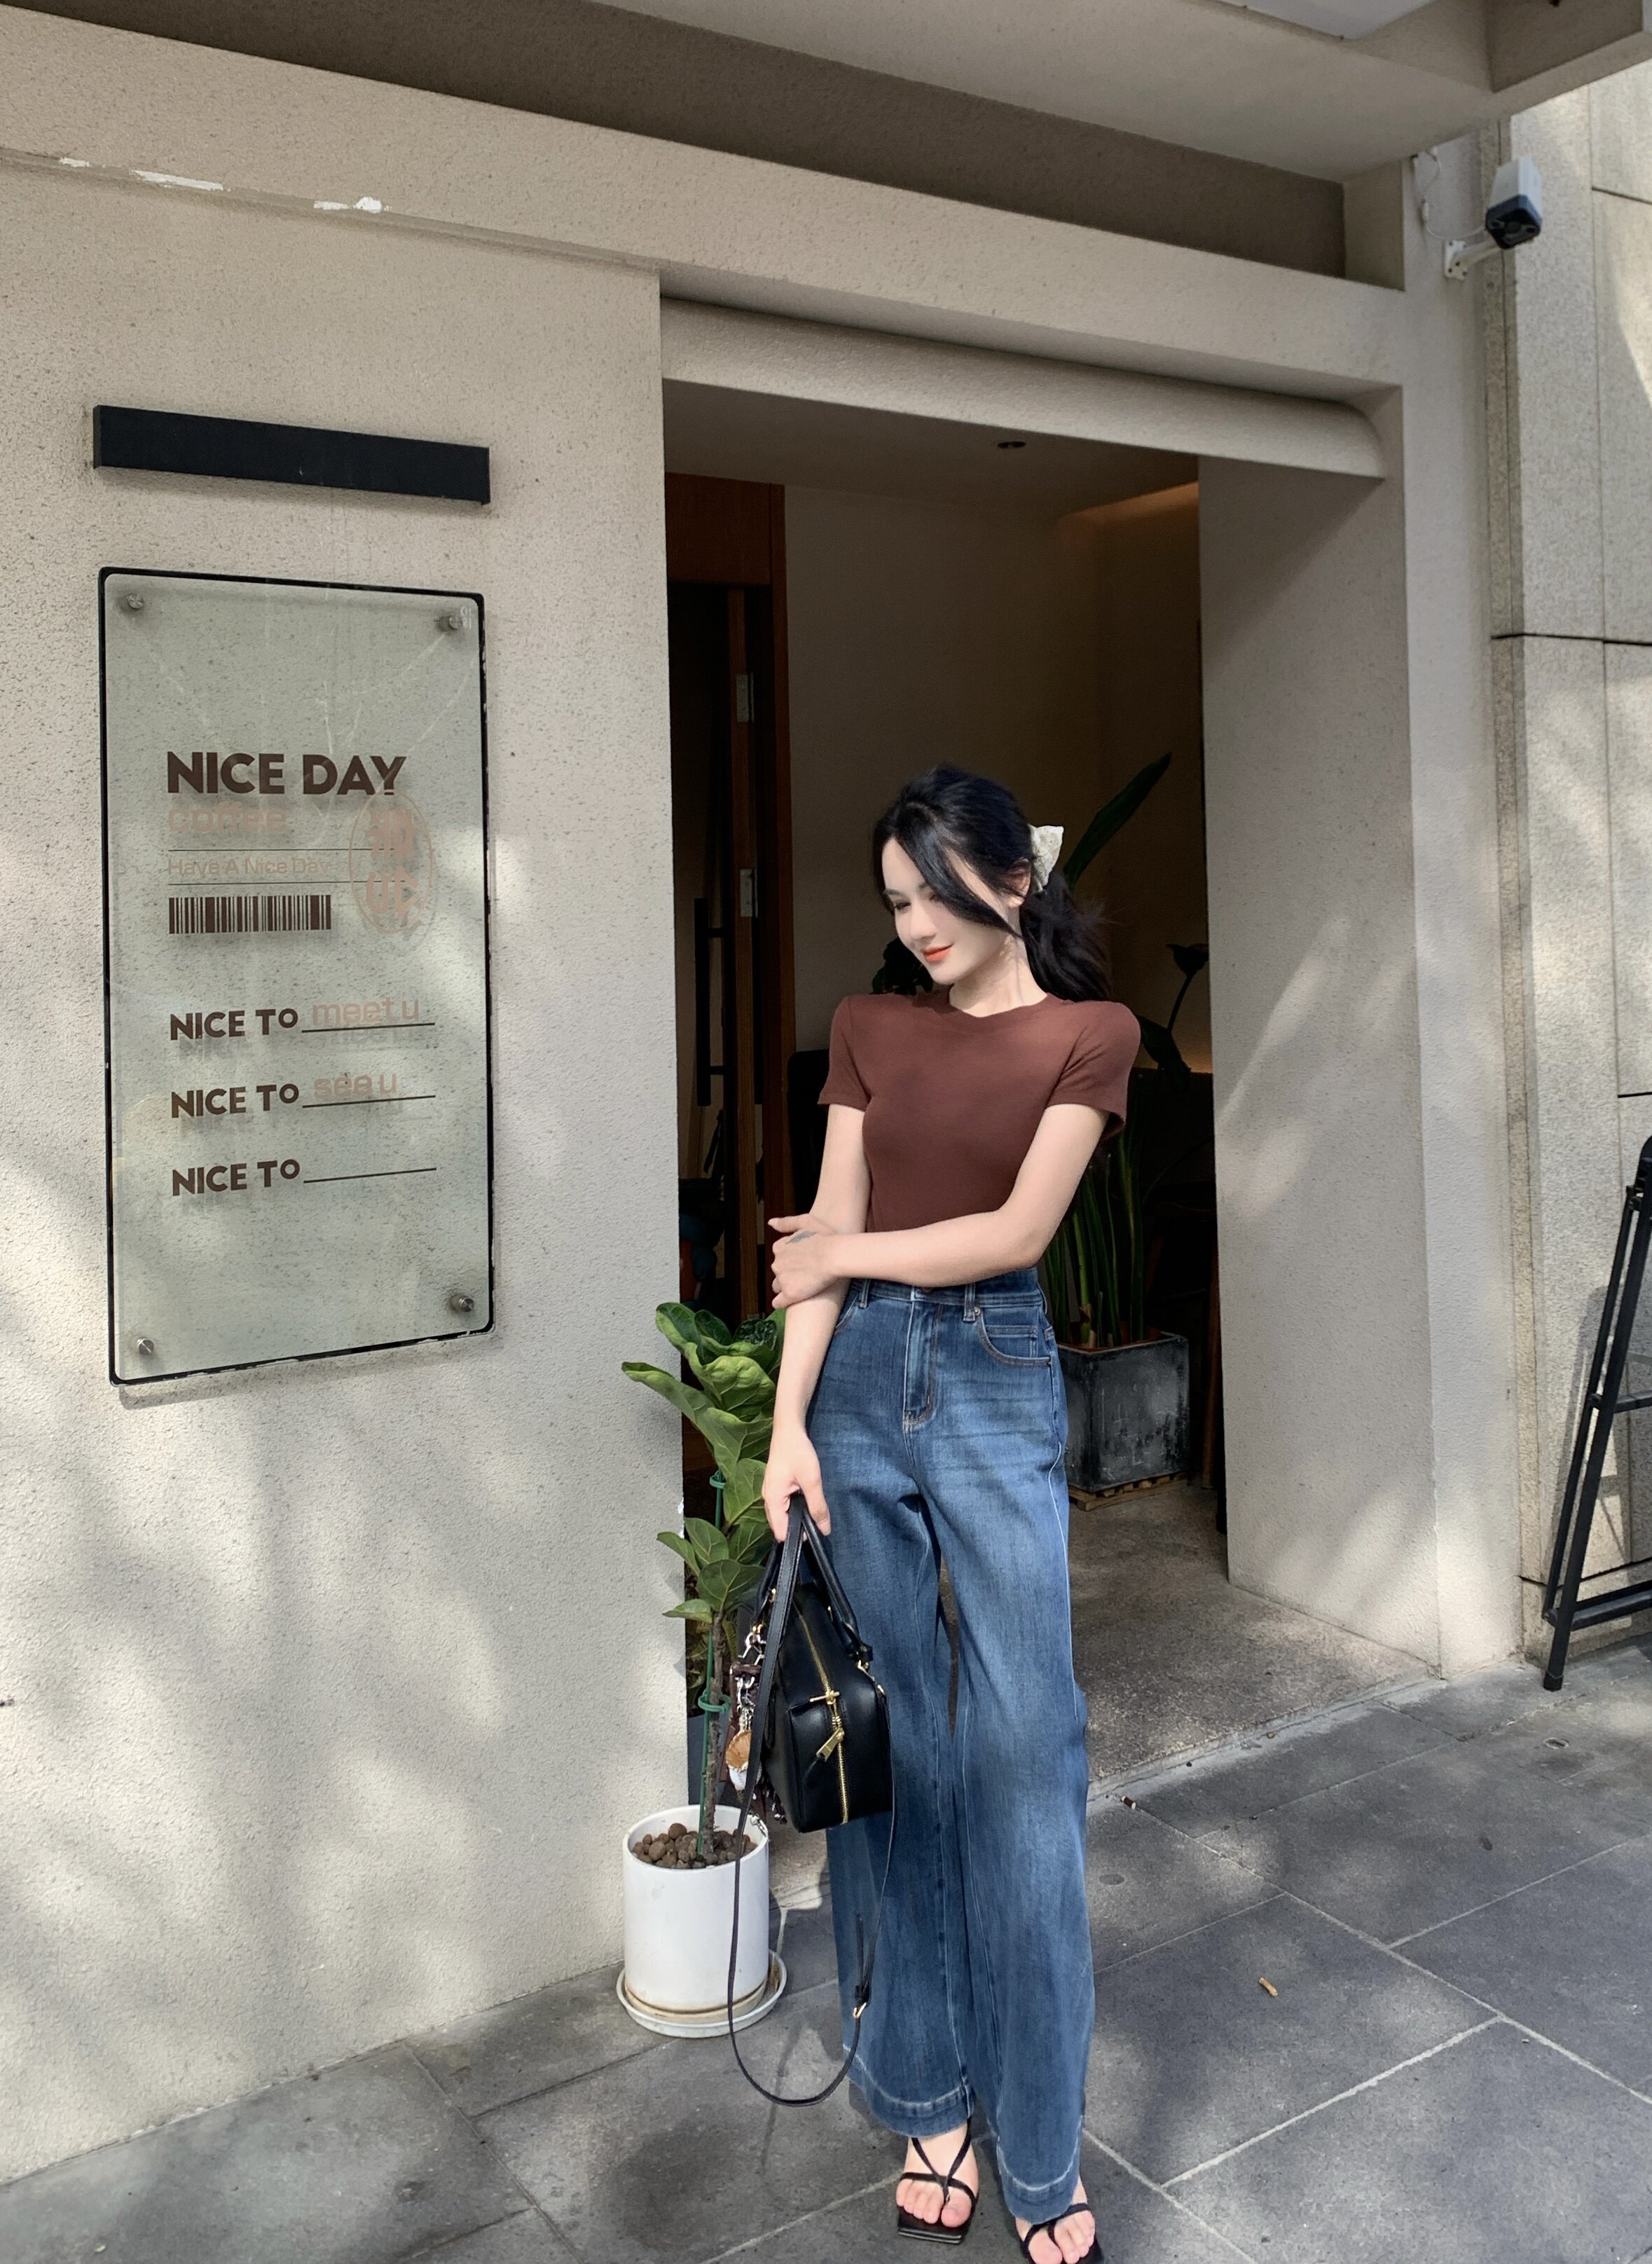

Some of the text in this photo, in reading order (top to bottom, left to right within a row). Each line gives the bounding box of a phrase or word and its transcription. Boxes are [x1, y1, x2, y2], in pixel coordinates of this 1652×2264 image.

[167, 751, 407, 795] NICE DAY
[168, 802, 287, 833] coffee
[168, 859, 220, 875] Have
[225, 859, 239, 874] A
[245, 857, 287, 874] Nice
[170, 1010, 245, 1041] NICE
[256, 1008, 298, 1036] TO
[312, 997, 396, 1026] meet
[171, 1073, 397, 1118] NICE TO see u
[172, 1159, 301, 1196] NICE TO
